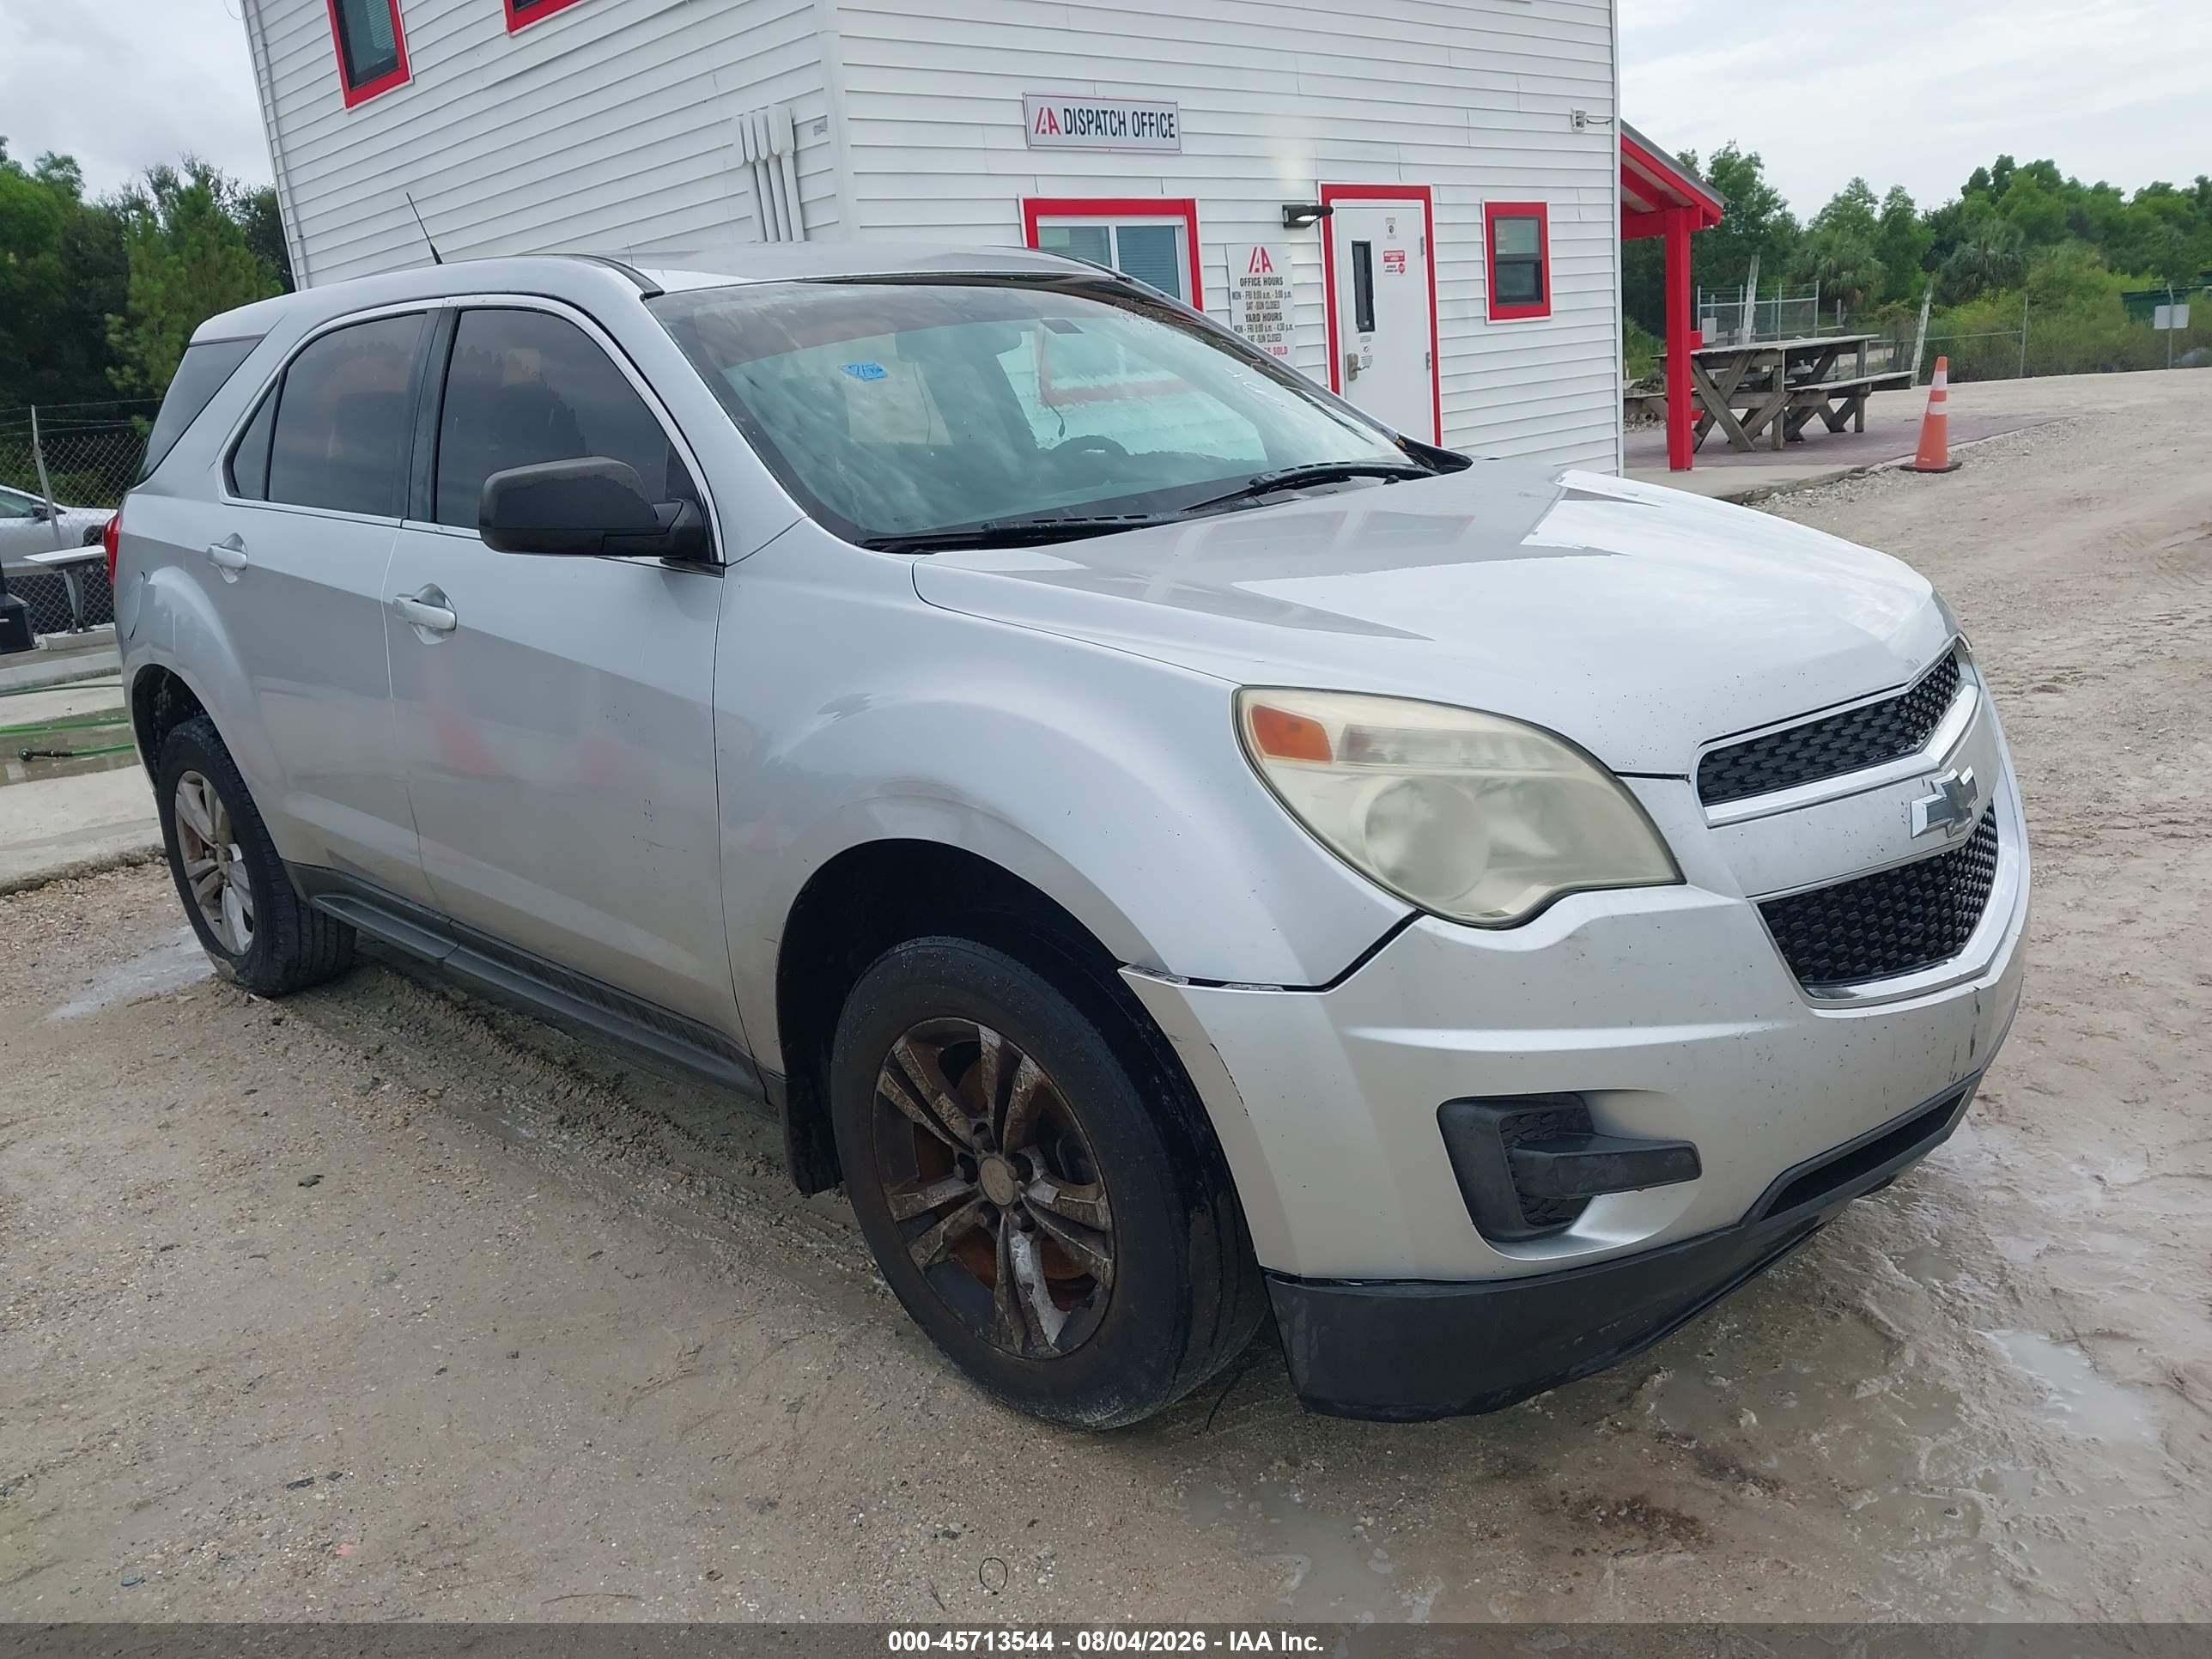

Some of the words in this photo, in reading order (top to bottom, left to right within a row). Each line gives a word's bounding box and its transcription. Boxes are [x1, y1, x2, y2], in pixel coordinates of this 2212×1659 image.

[1063, 107, 1127, 137] DISPATCH
[1132, 111, 1176, 138] OFFICE
[1239, 277, 1261, 287] OFFICE
[1262, 276, 1284, 286] HOURS
[1265, 301, 1280, 310] CLOSED
[1245, 313, 1261, 323] YARD
[1262, 312, 1283, 322] HOURS
[1267, 332, 1282, 343] CLOSED
[1273, 345, 1288, 356] SOLD
